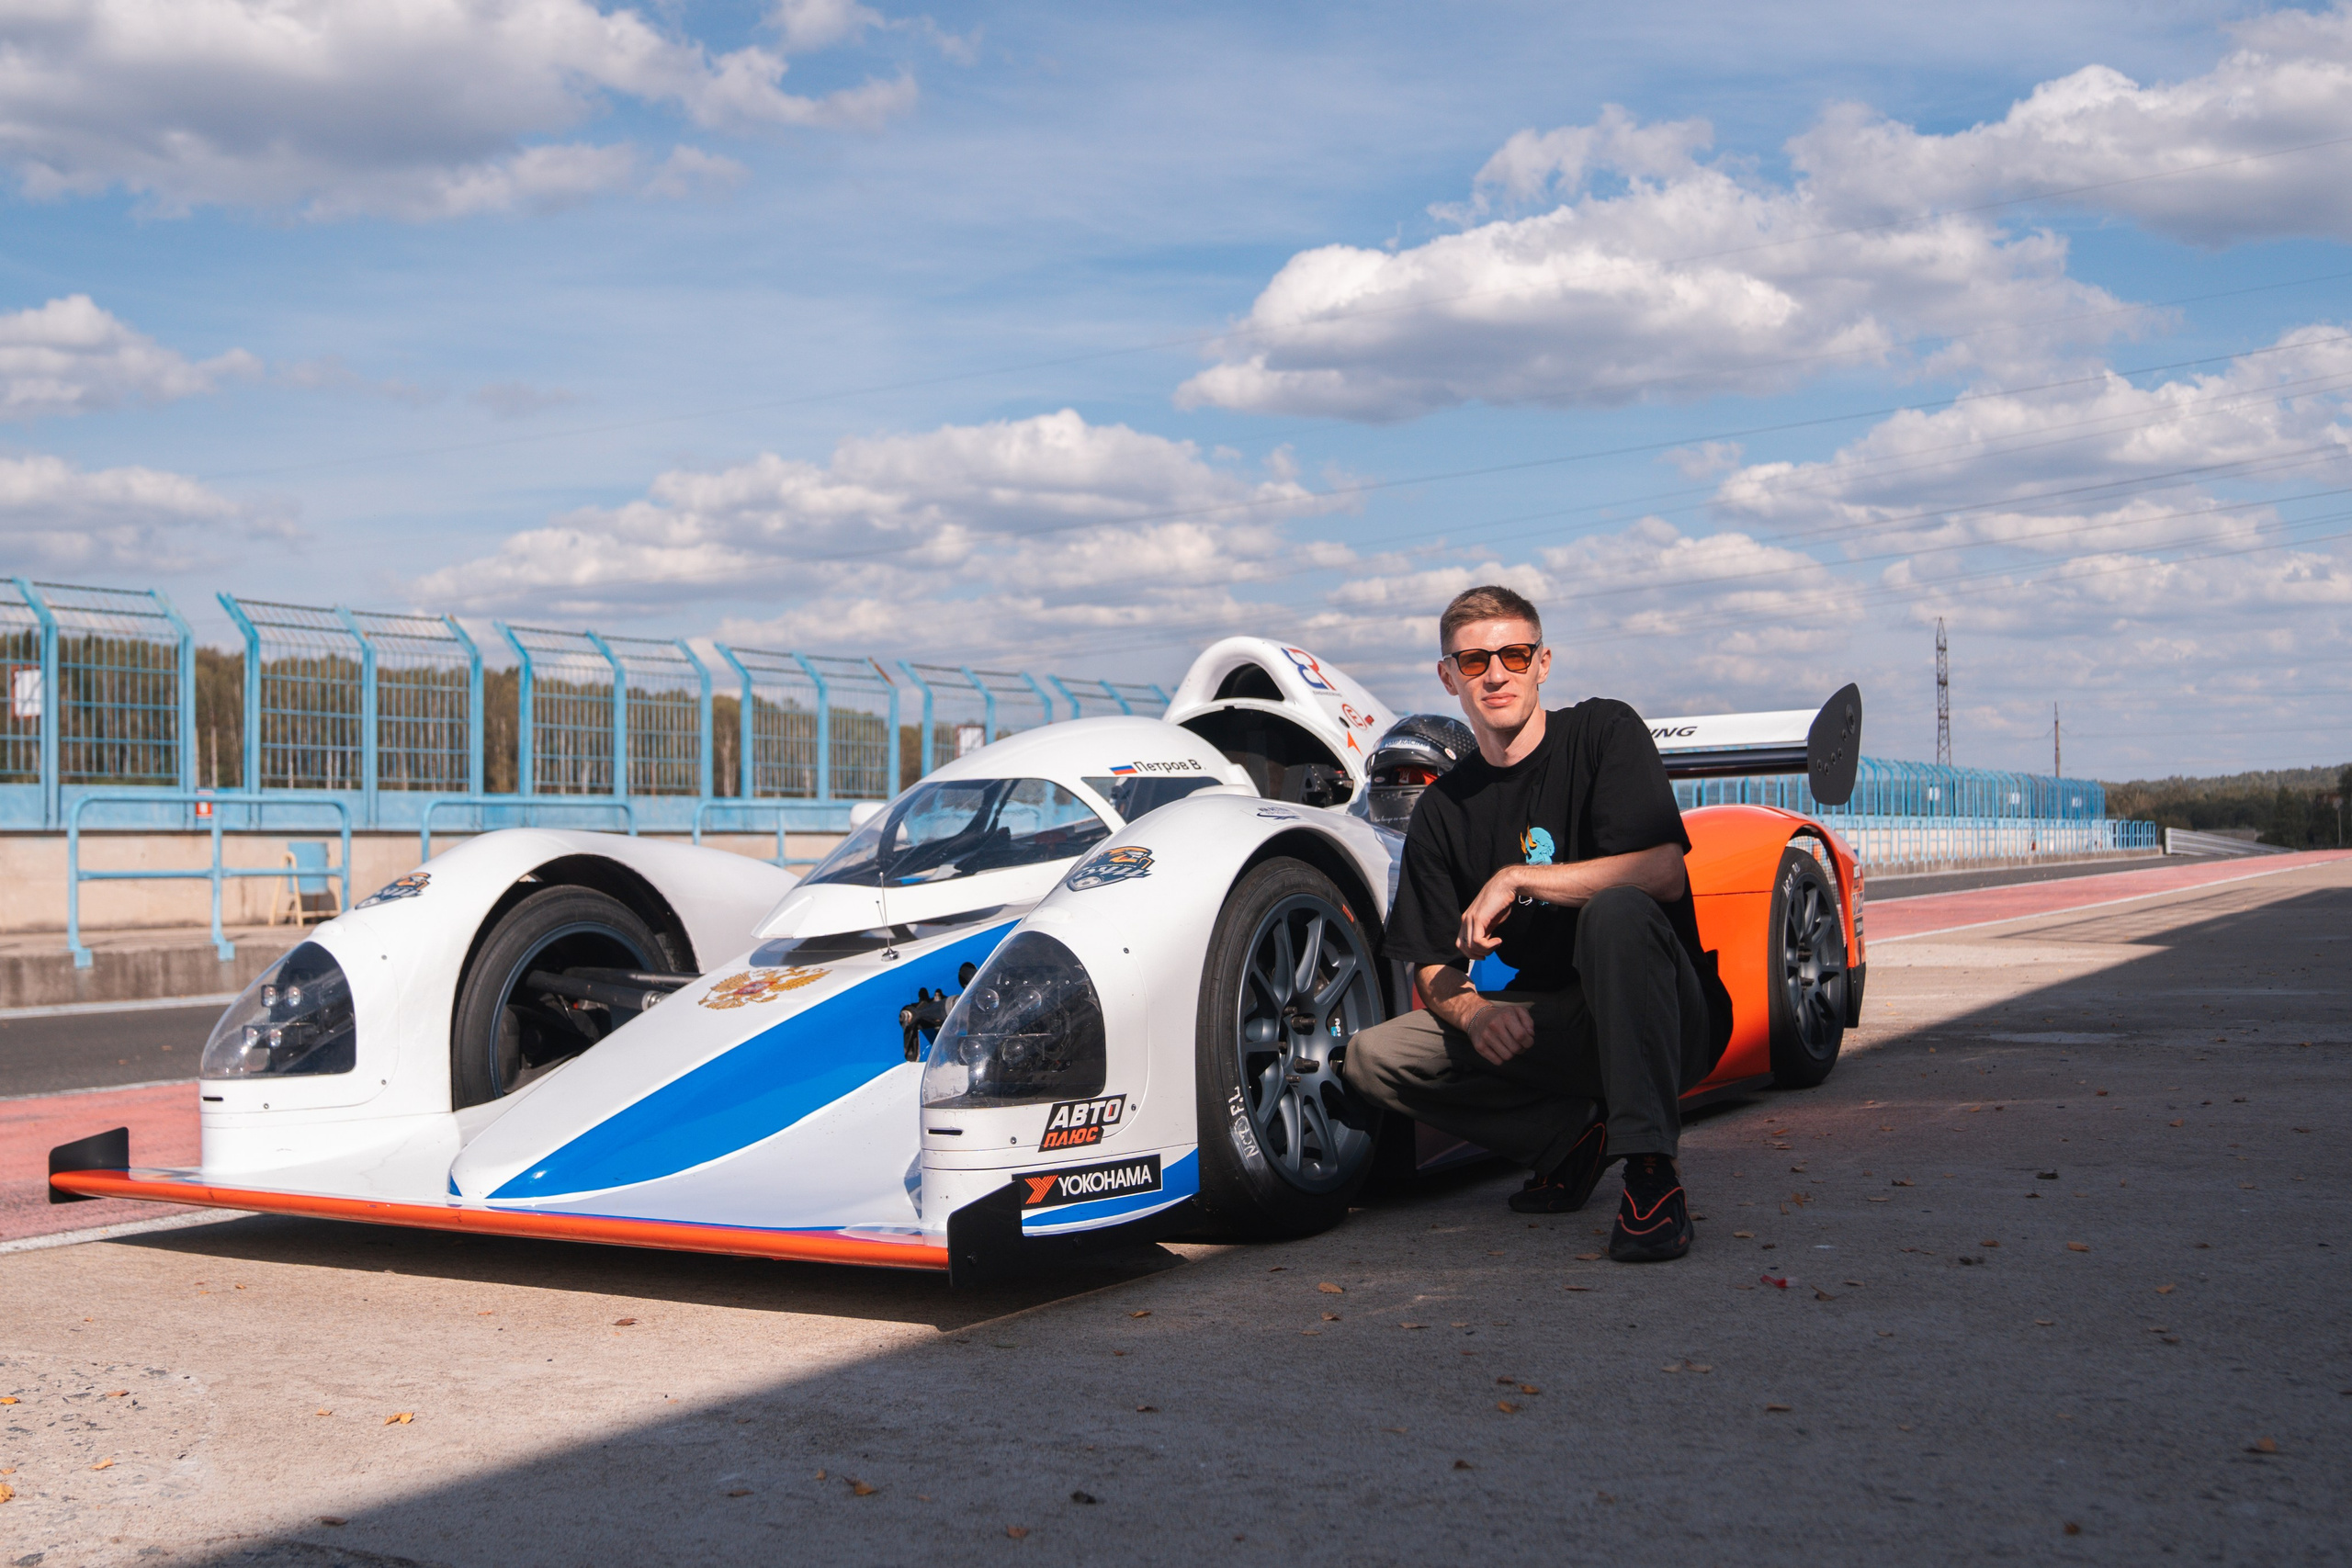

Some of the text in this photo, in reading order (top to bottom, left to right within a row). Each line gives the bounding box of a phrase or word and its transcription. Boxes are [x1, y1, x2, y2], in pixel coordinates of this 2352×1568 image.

[1649, 726, 1698, 739] ING
[1133, 761, 1190, 773] Петров
[1048, 1099, 1122, 1130] АВТО
[1044, 1126, 1099, 1148] ПЛЮС
[1057, 1165, 1152, 1196] YOKOHAMA
